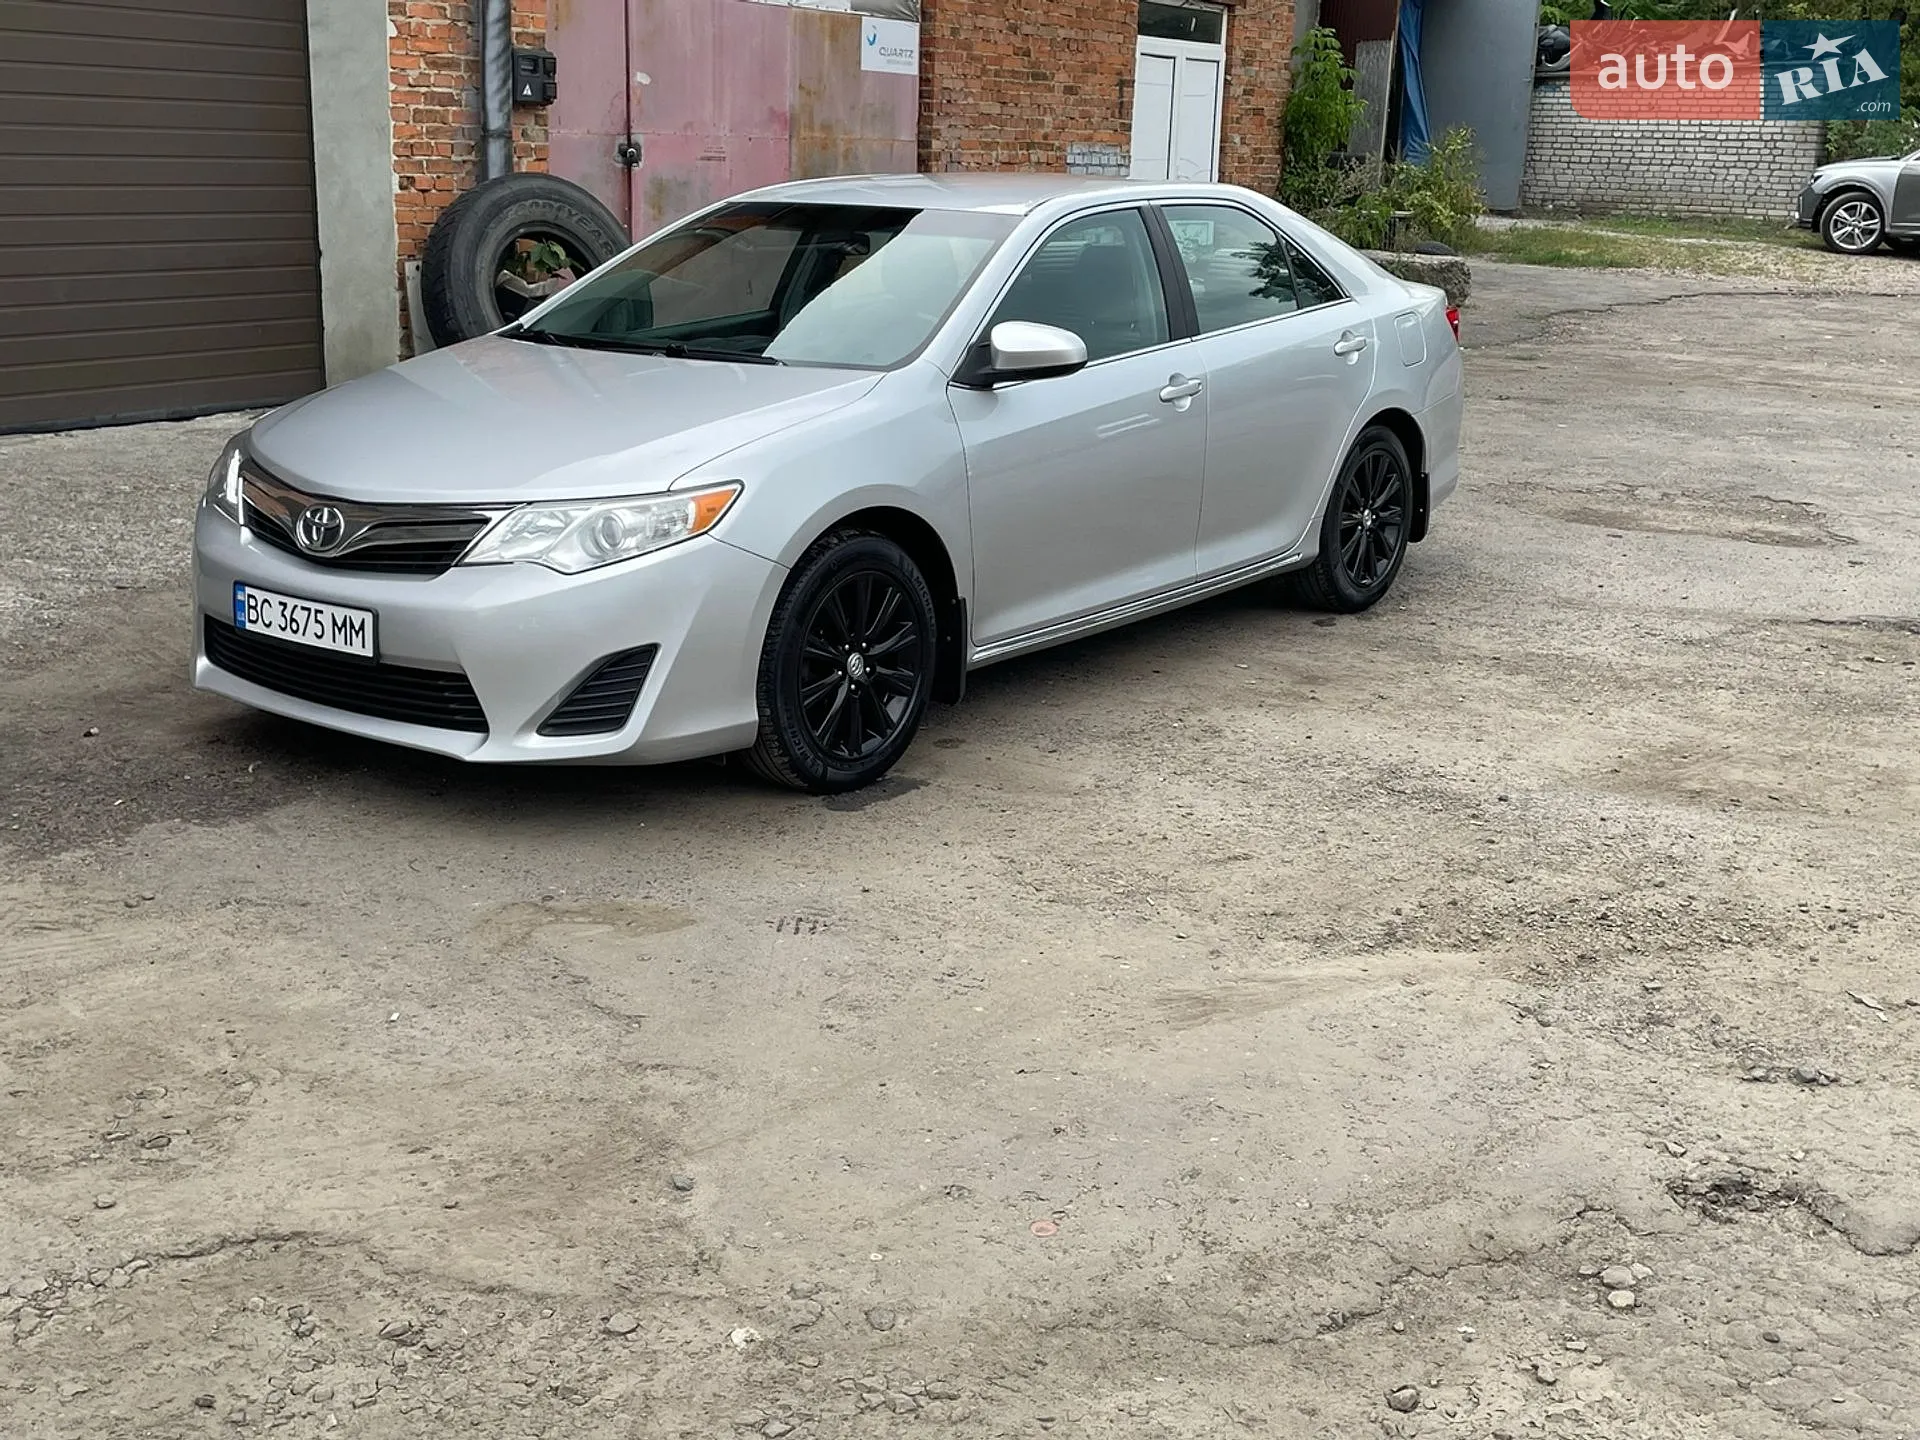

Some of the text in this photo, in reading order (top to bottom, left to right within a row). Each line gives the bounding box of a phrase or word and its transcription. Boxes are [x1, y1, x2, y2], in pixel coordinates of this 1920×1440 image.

[879, 47, 914, 59] QUARTZ
[246, 593, 365, 649] BC 3675 MM
